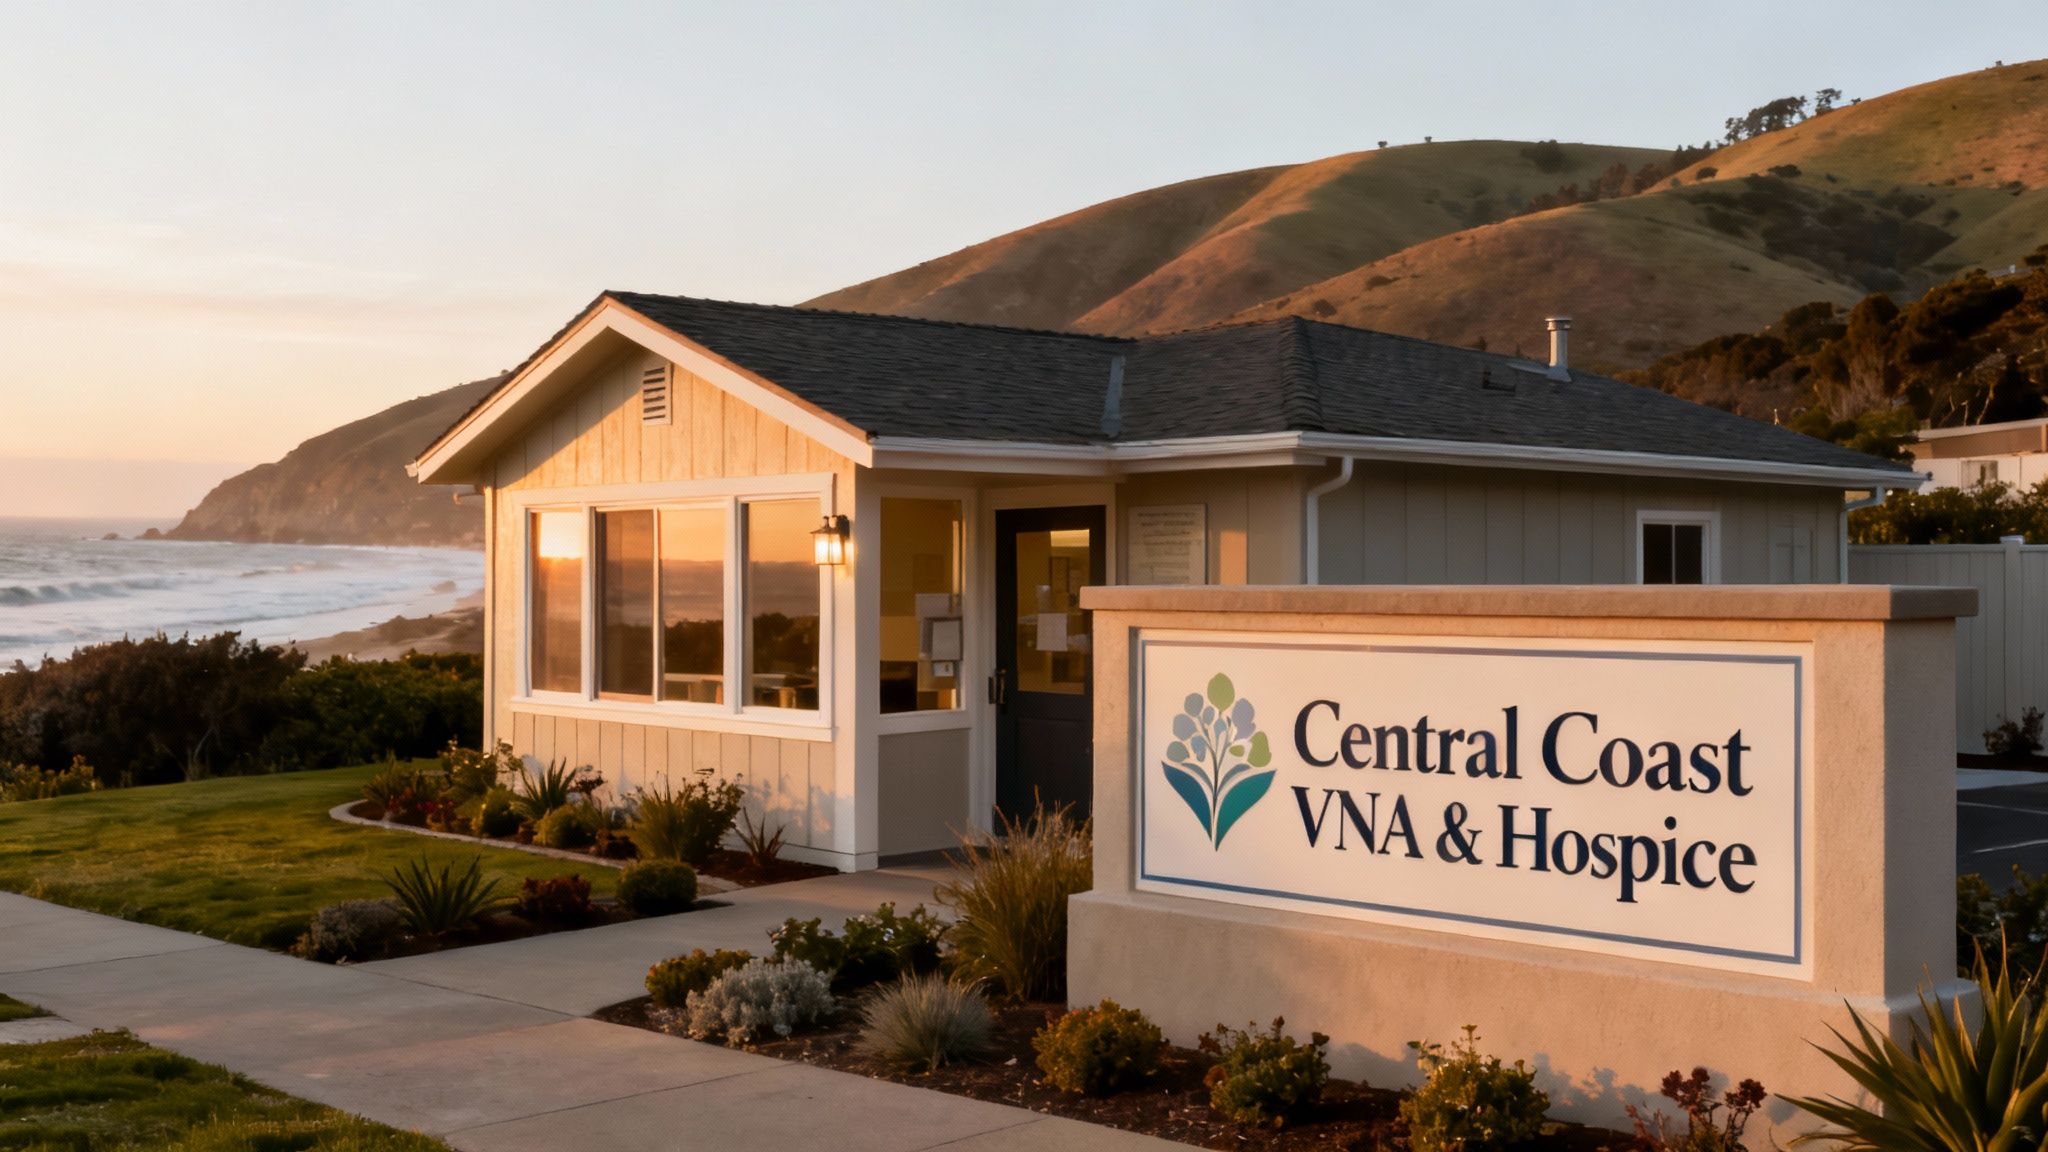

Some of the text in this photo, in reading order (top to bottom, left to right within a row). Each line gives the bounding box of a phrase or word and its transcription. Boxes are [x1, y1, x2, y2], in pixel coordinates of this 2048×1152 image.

[1294, 699, 1754, 797] Central Coast
[1290, 785, 1758, 904] VNA & Hospice
